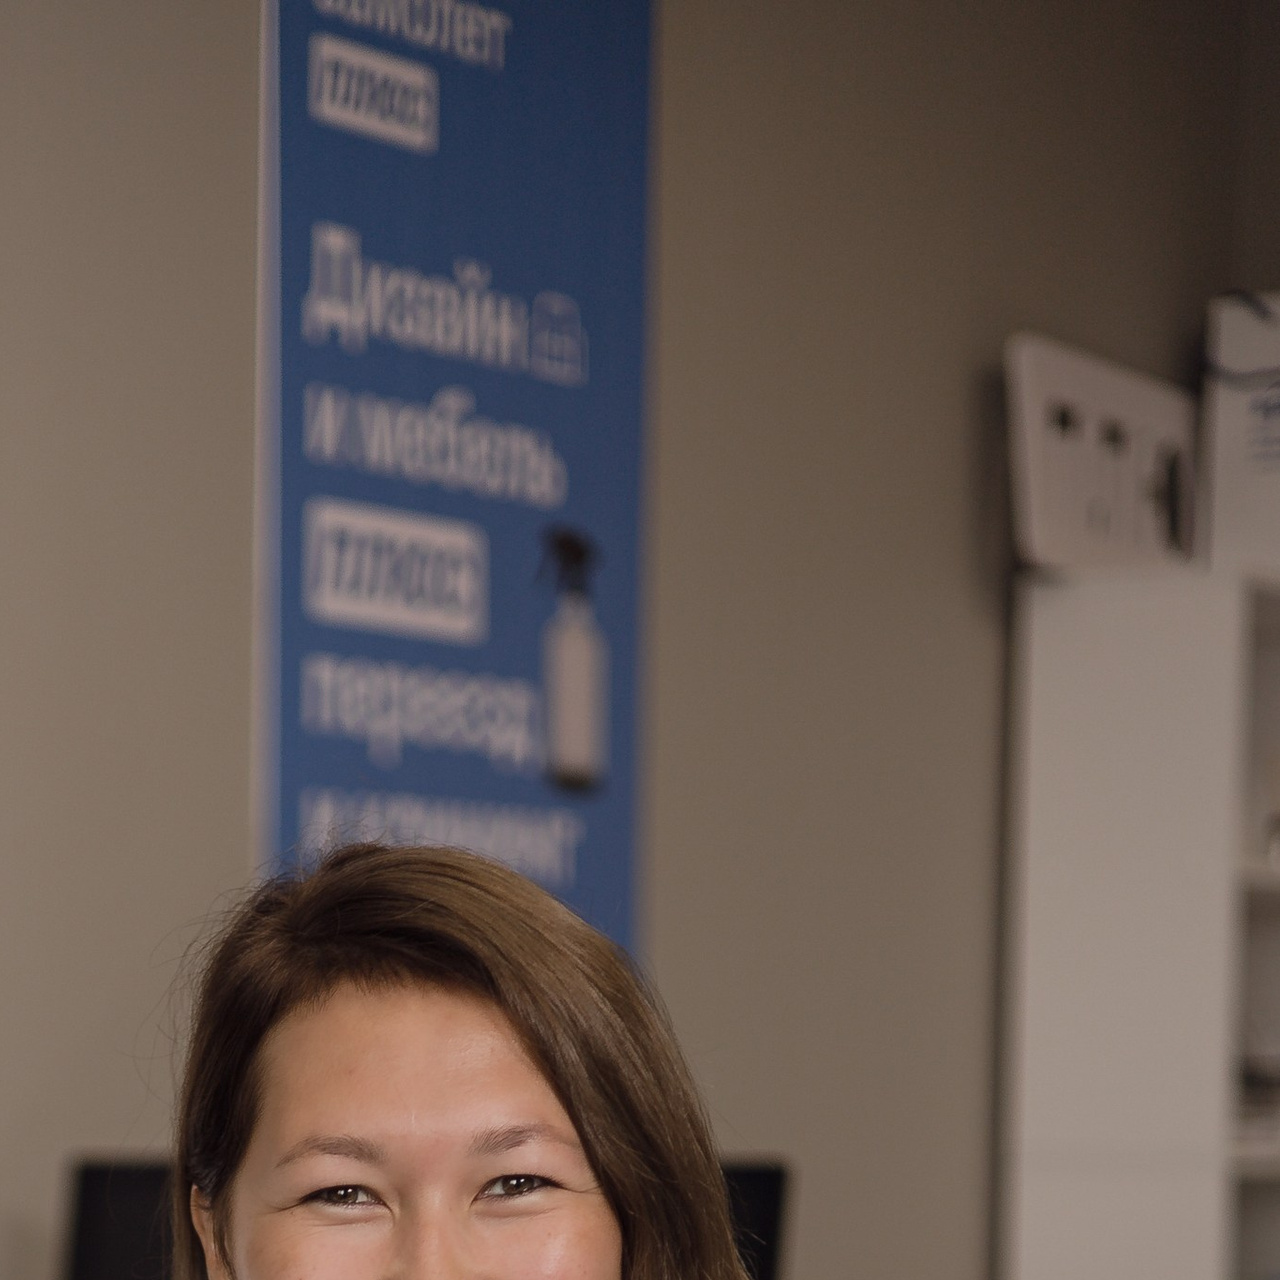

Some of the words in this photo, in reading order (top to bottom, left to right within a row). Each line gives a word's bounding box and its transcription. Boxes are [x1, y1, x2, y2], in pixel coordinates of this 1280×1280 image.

[302, 222, 530, 375] Дизайн
[357, 385, 569, 509] мебель
[322, 525, 472, 620] плюс
